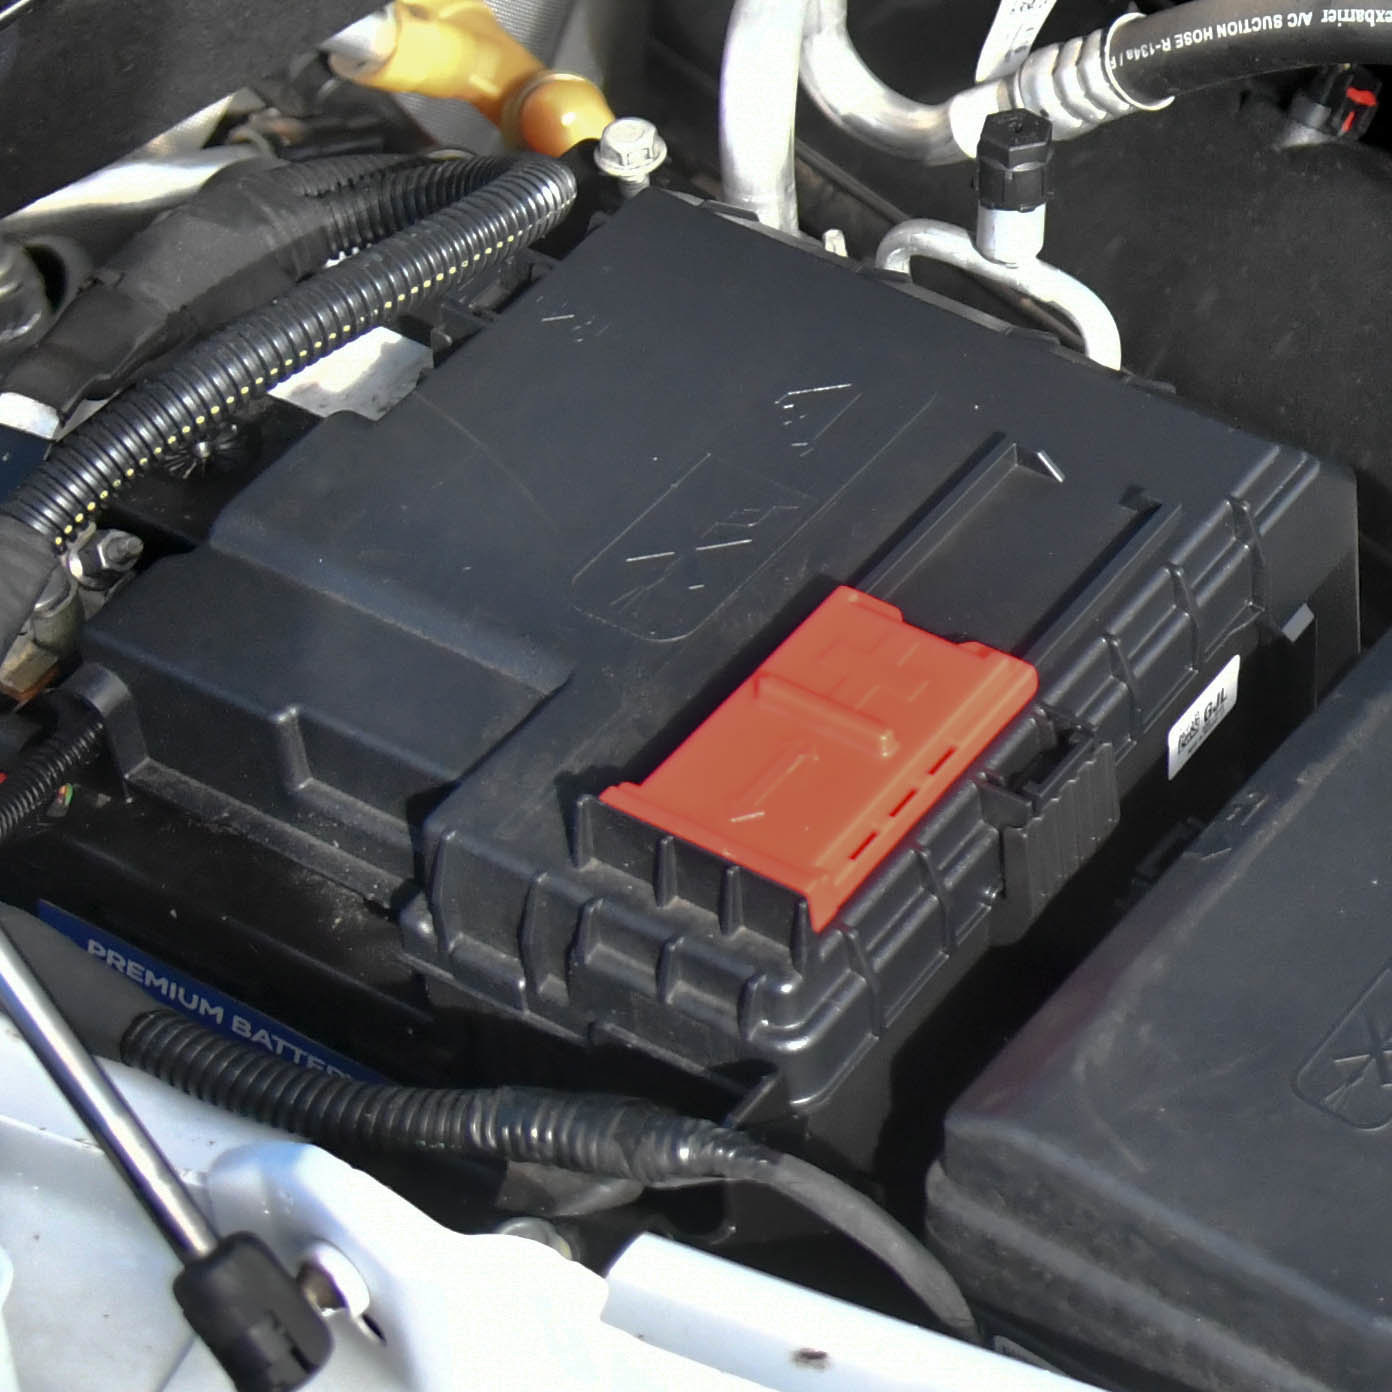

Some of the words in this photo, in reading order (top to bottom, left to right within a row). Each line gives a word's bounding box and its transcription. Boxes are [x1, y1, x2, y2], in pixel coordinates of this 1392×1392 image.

[1217, 14, 1282, 38] SUCTION
[1287, 12, 1312, 28] A/C
[1126, 37, 1171, 60] R-134a
[1174, 26, 1213, 48] HOSE
[87, 938, 224, 1024] PREMIUM
